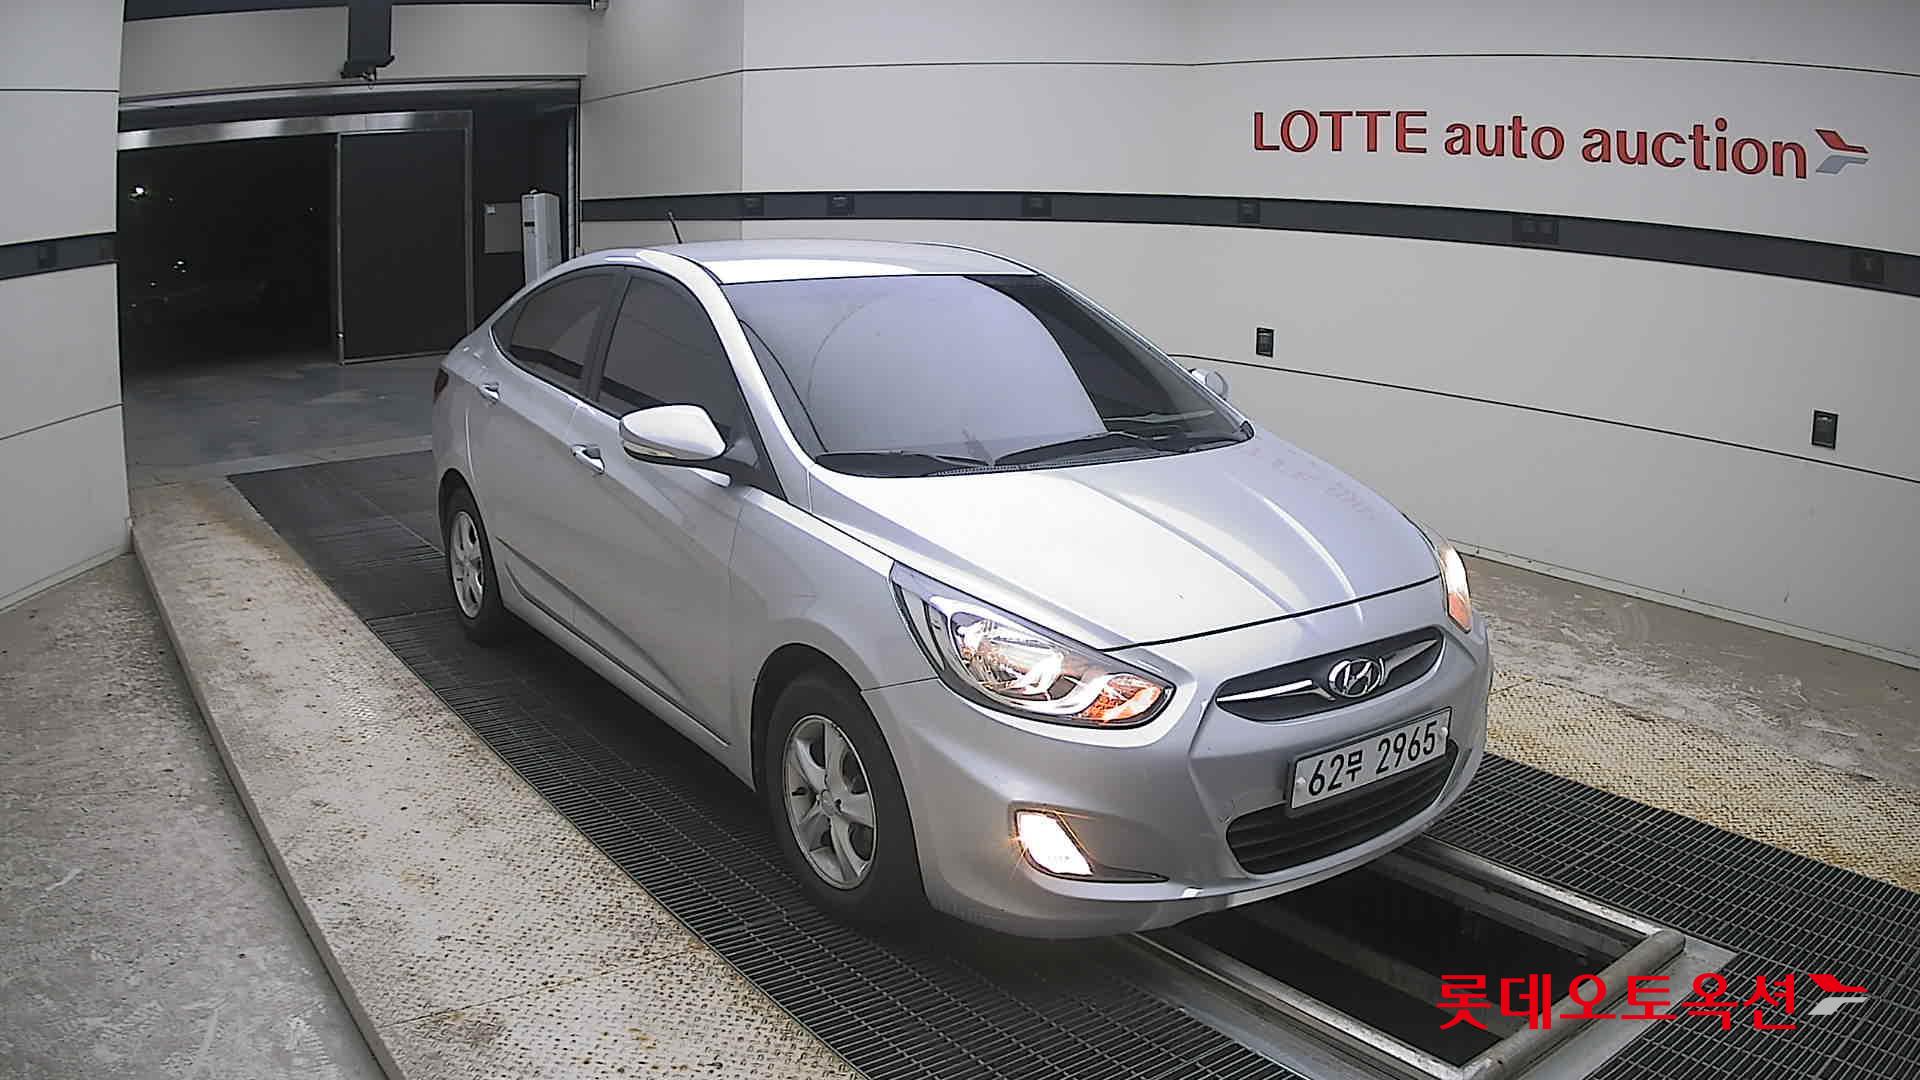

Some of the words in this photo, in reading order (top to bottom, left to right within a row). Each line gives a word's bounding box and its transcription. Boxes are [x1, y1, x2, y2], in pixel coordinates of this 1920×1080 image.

[1254, 110, 1427, 154] LOTTE
[1444, 115, 1565, 161] auto
[1581, 117, 1807, 179] auction
[1308, 749, 1363, 797] 62무
[1376, 720, 1437, 774] 2965
